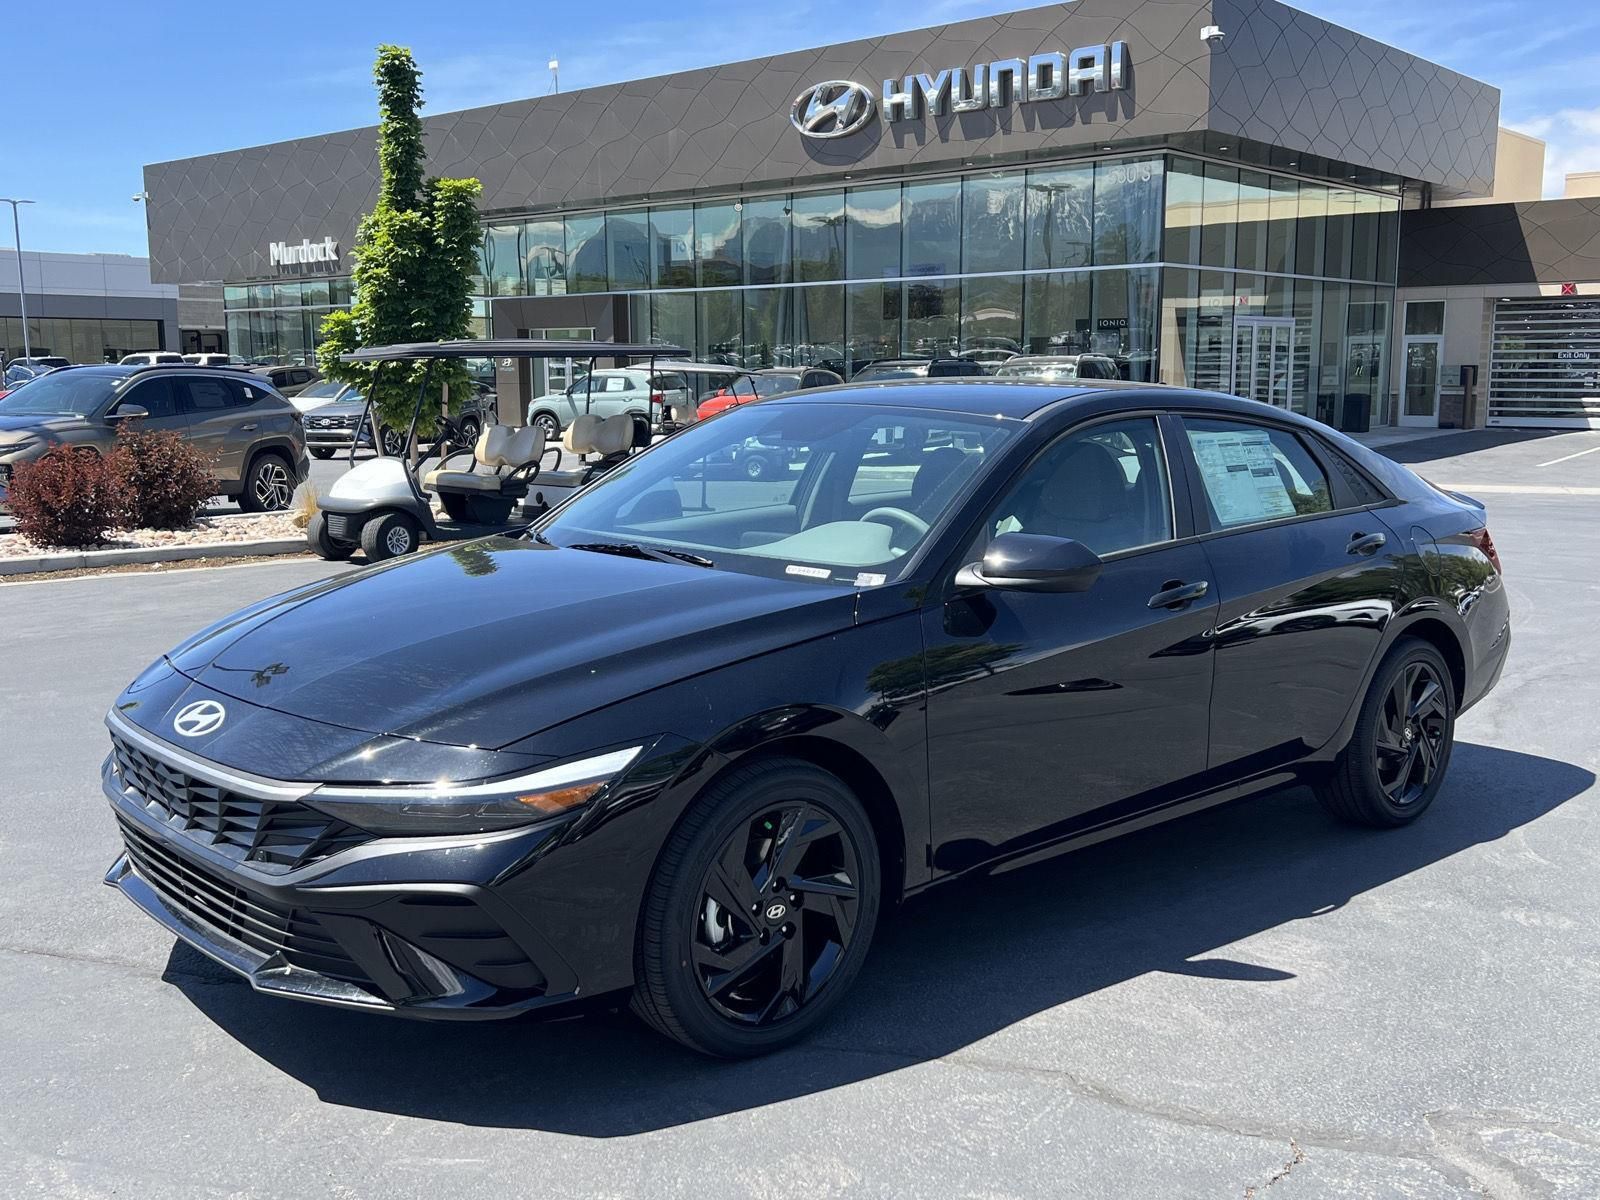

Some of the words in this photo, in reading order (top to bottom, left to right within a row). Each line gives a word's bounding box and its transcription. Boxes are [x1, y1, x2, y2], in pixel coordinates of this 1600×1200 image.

[883, 40, 1128, 122] HYUNDAI
[1141, 164, 1152, 182] S
[269, 236, 339, 266] Murdock
[1573, 352, 1590, 361] Only
